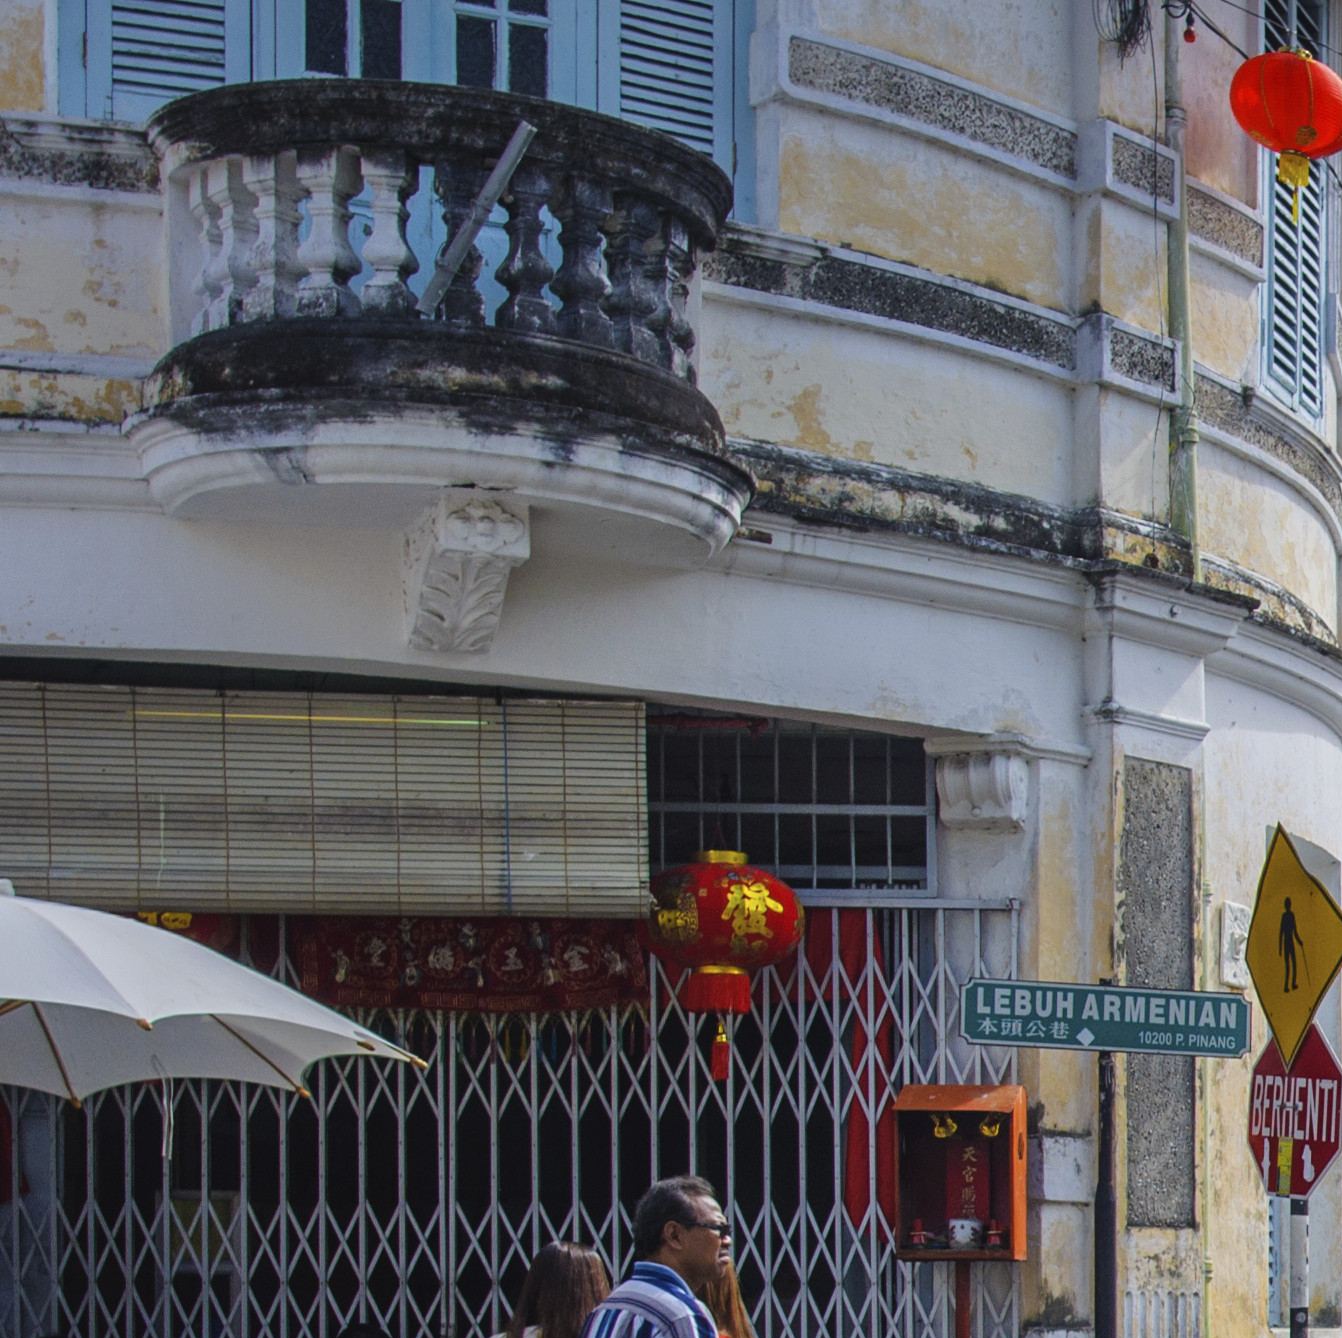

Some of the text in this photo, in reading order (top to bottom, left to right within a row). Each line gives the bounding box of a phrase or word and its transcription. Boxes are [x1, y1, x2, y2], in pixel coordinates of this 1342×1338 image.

[976, 987, 1238, 1029] LEBUH ARMENIAN
[976, 1017, 1070, 1040] 本頭公巷
[1138, 1031, 1236, 1050] 10200 P. PINANG
[1251, 1074, 1338, 1143] BERHENTI
